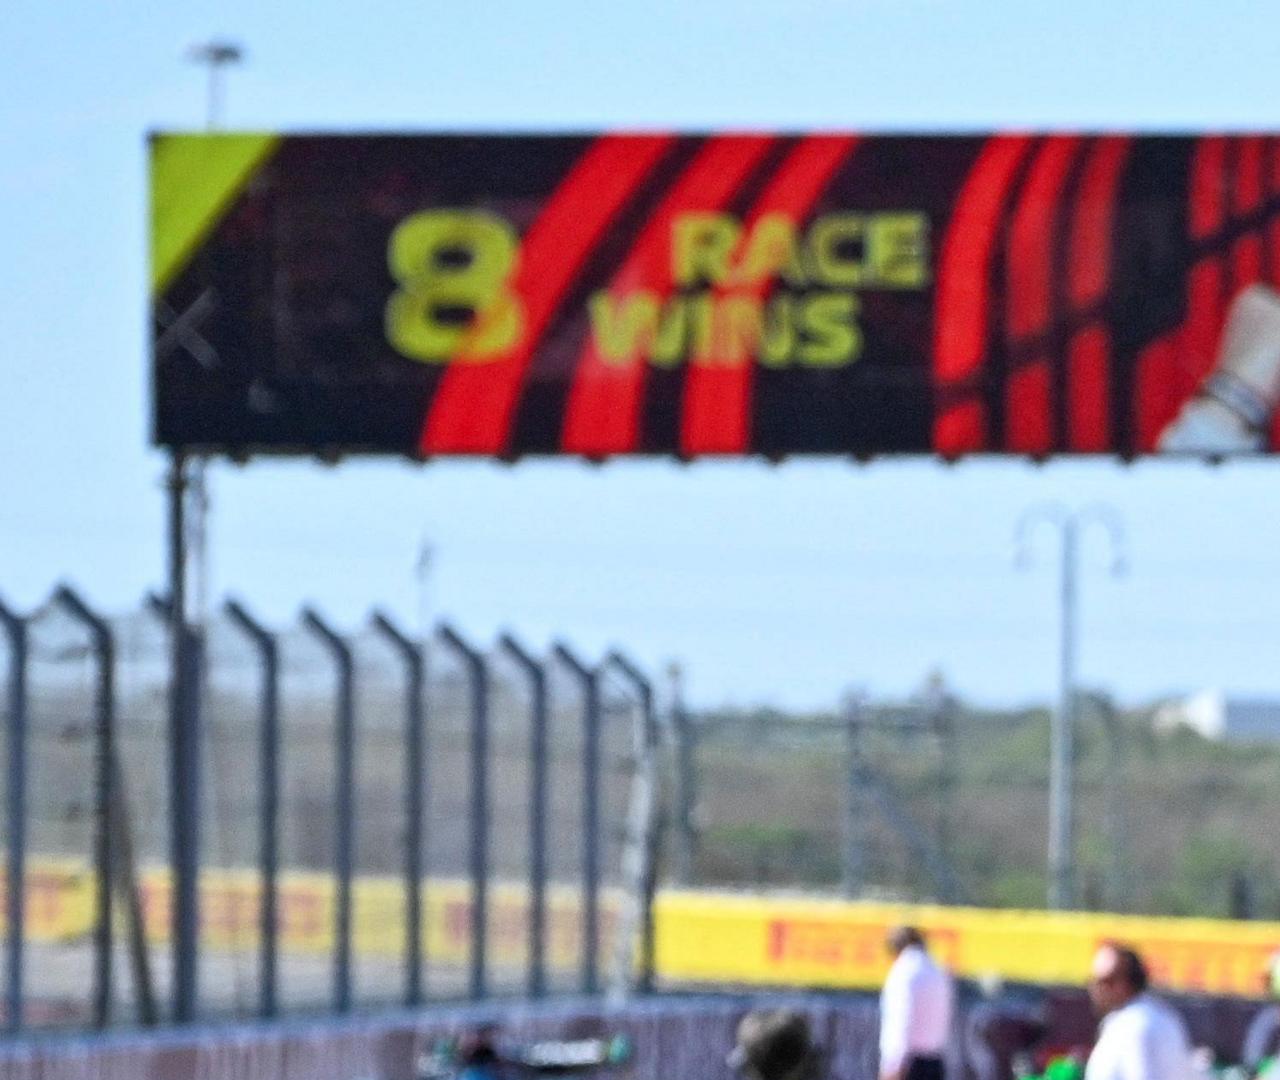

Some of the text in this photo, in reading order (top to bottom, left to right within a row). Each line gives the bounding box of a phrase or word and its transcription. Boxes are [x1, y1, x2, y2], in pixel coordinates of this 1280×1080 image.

[386, 208, 522, 362] 8
[671, 213, 928, 286] RACE
[589, 294, 864, 367] WINS
